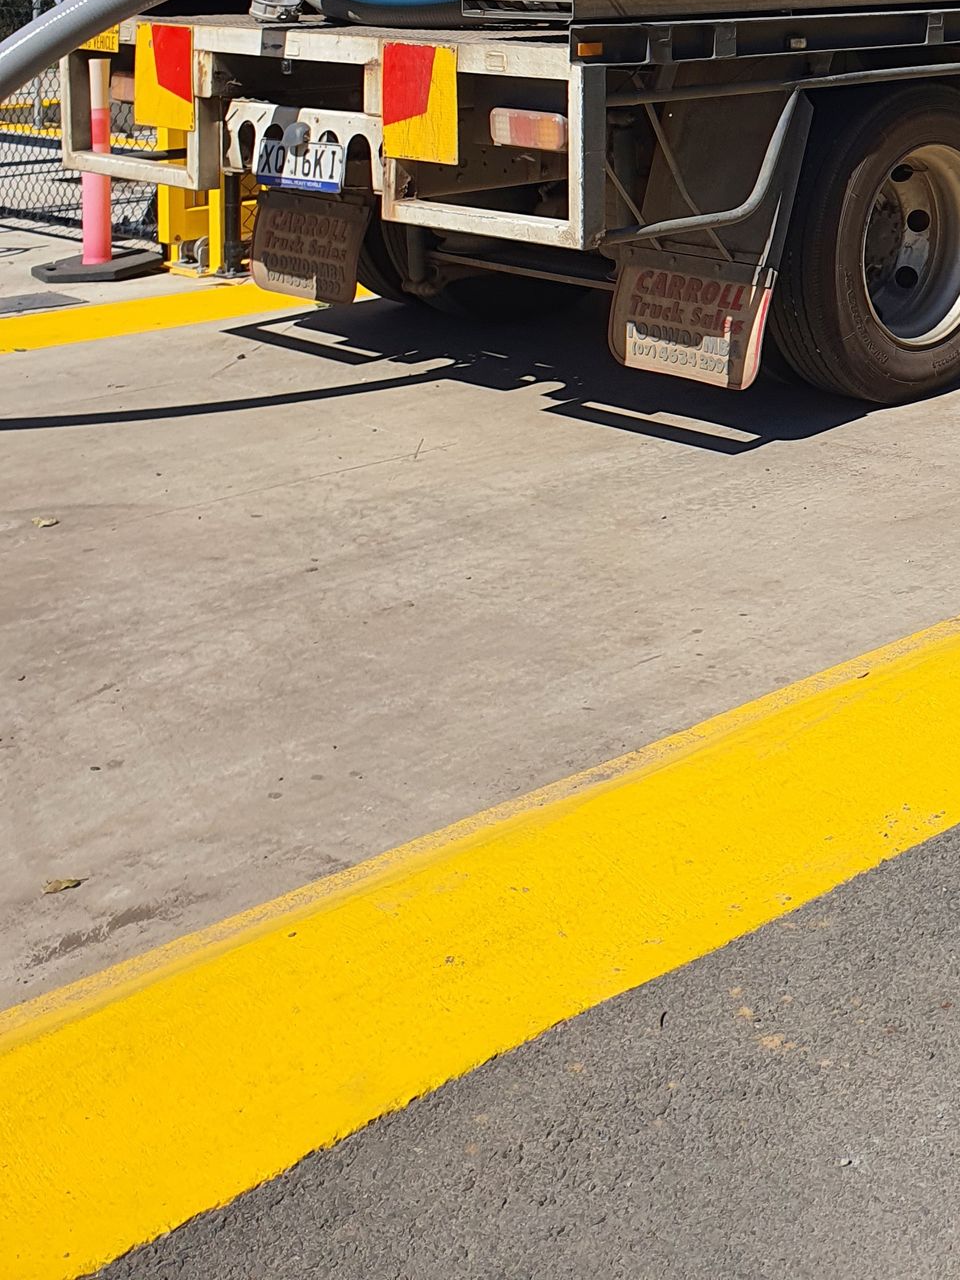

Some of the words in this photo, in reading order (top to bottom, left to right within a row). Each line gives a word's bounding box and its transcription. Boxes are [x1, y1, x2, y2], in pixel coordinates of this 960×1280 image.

[271, 210, 348, 242] CARROLL
[636, 270, 746, 311] CARROLL
[630, 294, 684, 324] Truck
[690, 306, 745, 335] Sales
[658, 347, 698, 367] 4634
